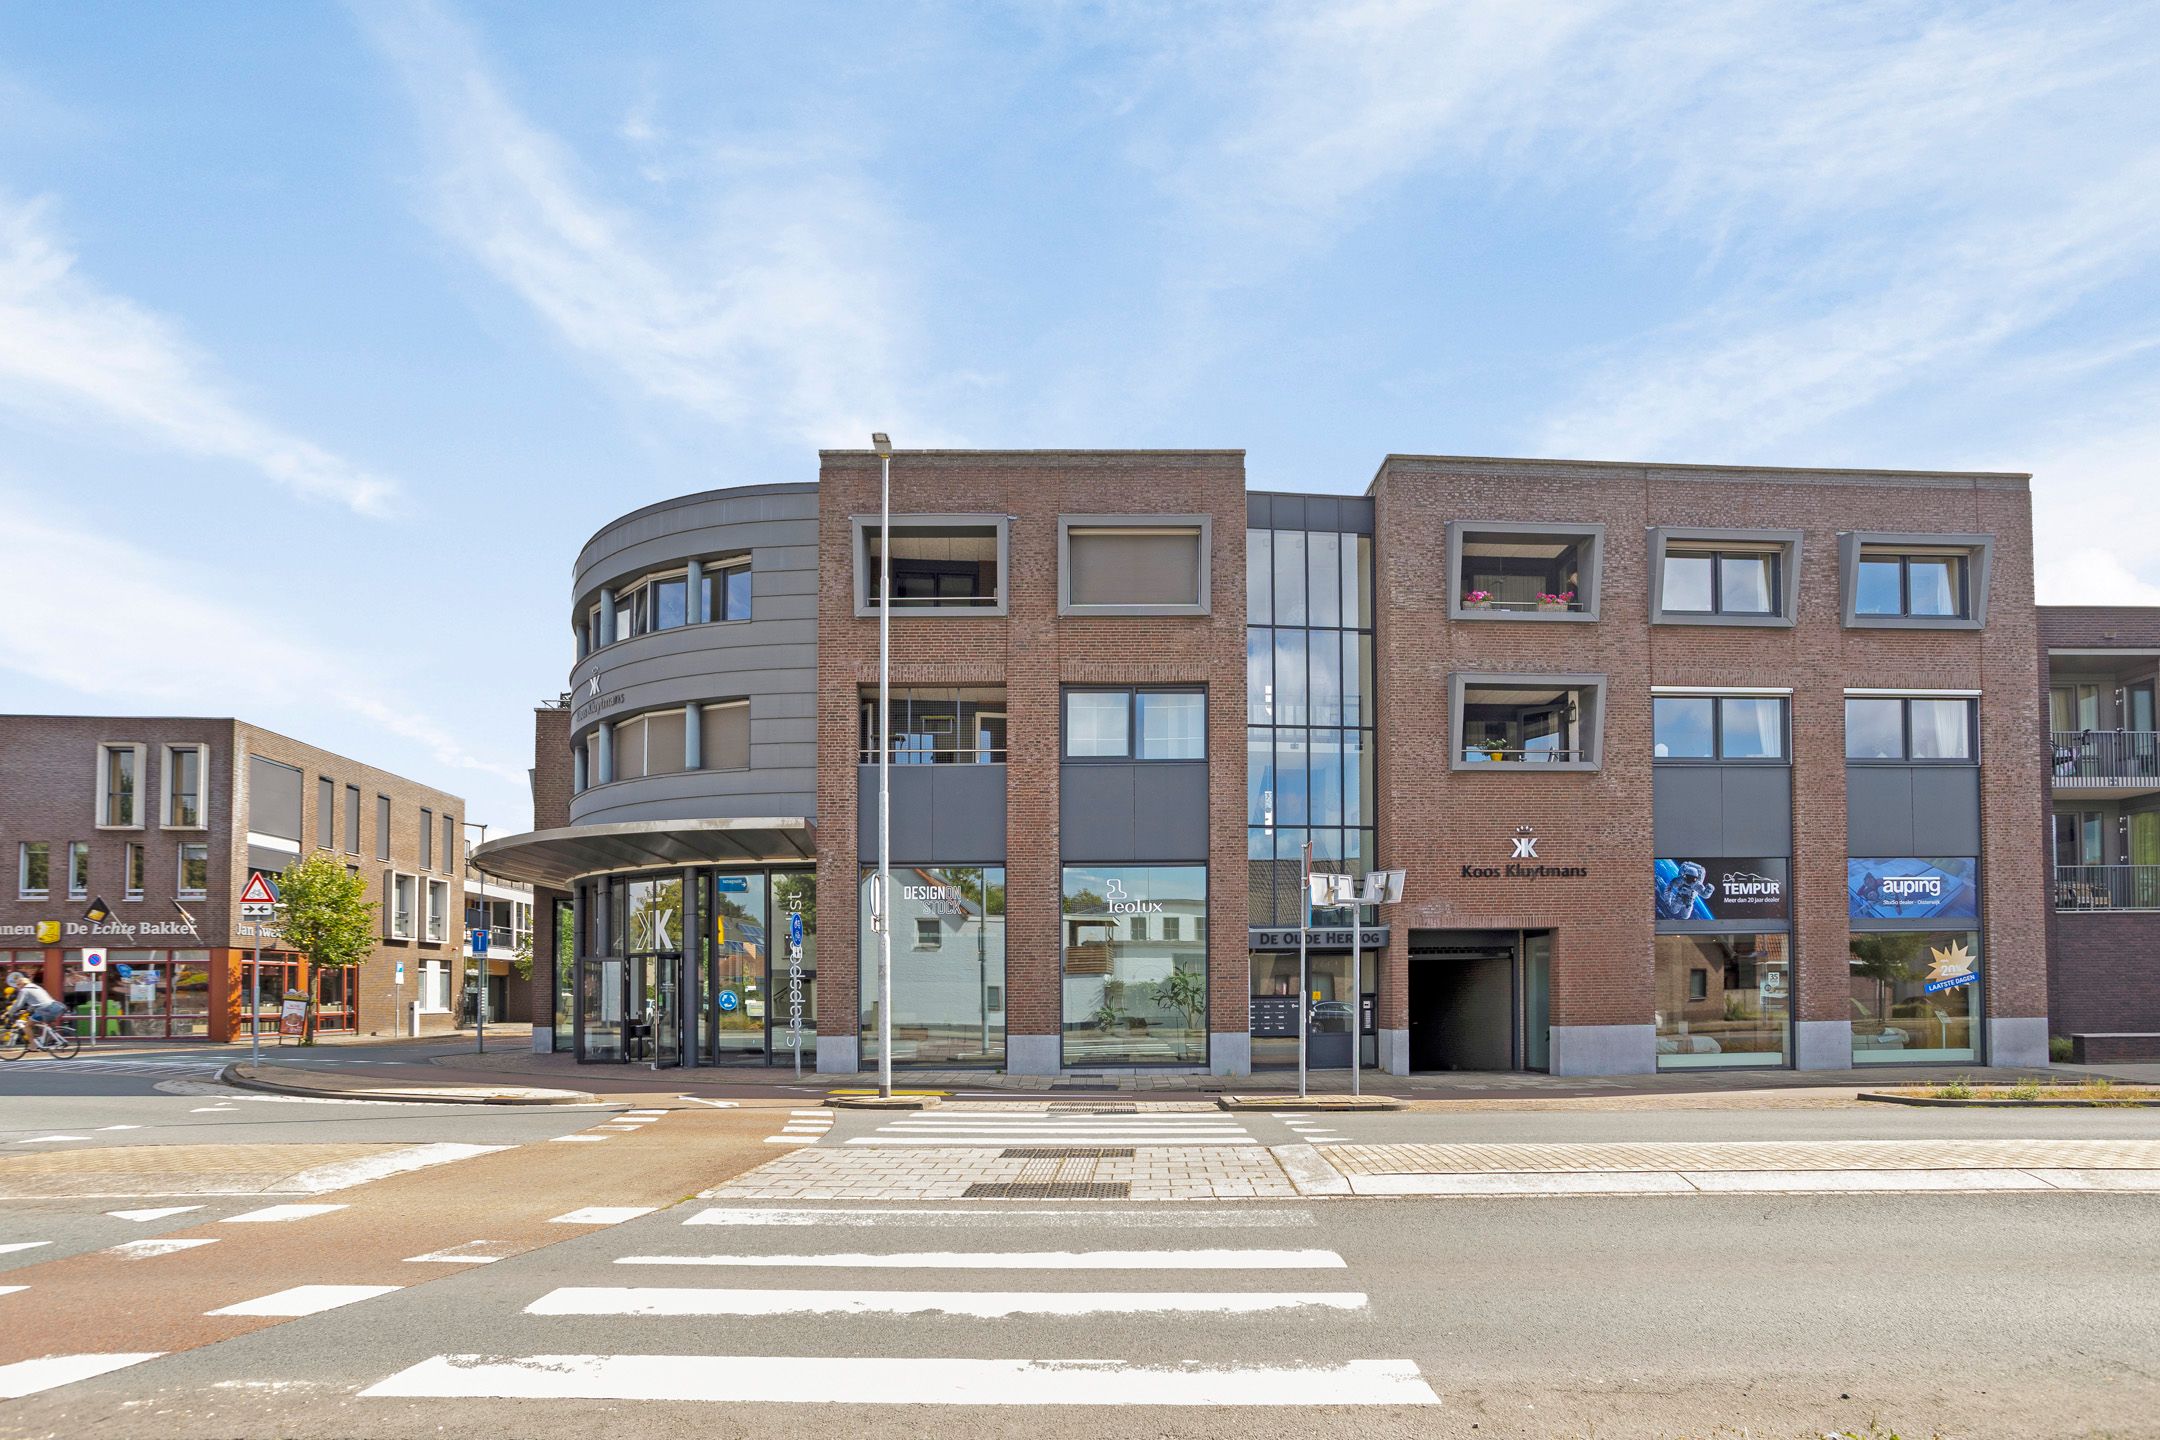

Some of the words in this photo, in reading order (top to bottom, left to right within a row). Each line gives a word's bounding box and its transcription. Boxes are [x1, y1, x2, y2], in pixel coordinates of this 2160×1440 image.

[1461, 864, 1501, 878] Koos
[1505, 864, 1588, 881] Kluytmans
[1722, 882, 1781, 895] TEMPUR
[1882, 879, 1941, 897] auping
[922, 900, 962, 915] STOCK
[1106, 899, 1163, 914] leolux
[66, 922, 89, 935] De
[92, 921, 136, 935] Echte
[139, 921, 198, 935] Bakker
[236, 922, 255, 936] Jan
[1928, 979, 1956, 991] LAATSTE
[1955, 974, 1976, 985] DAGEN
